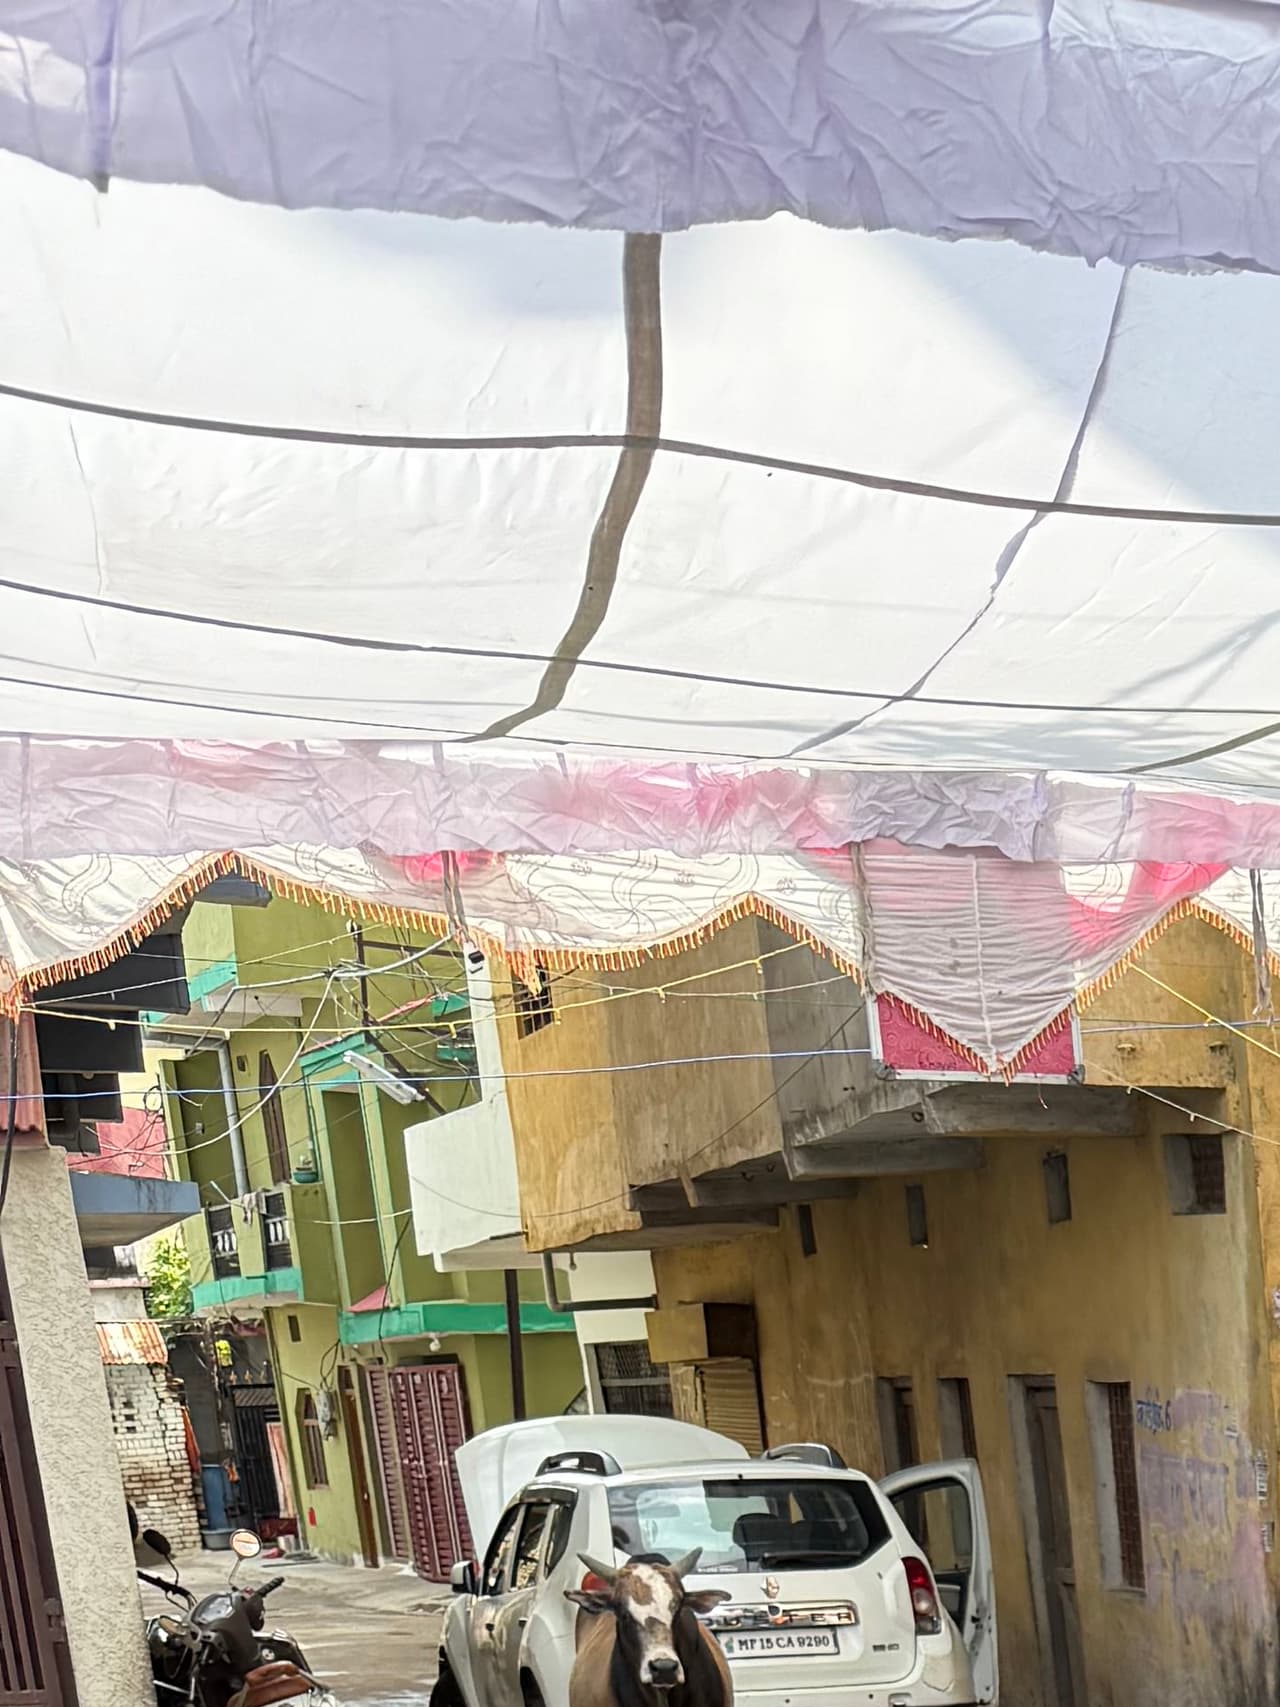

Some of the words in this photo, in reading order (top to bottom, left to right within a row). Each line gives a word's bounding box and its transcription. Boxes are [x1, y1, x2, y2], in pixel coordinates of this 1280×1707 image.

[760, 1637, 774, 1651] 15
[775, 1636, 795, 1650] CA
[798, 1635, 830, 1649] 9290
